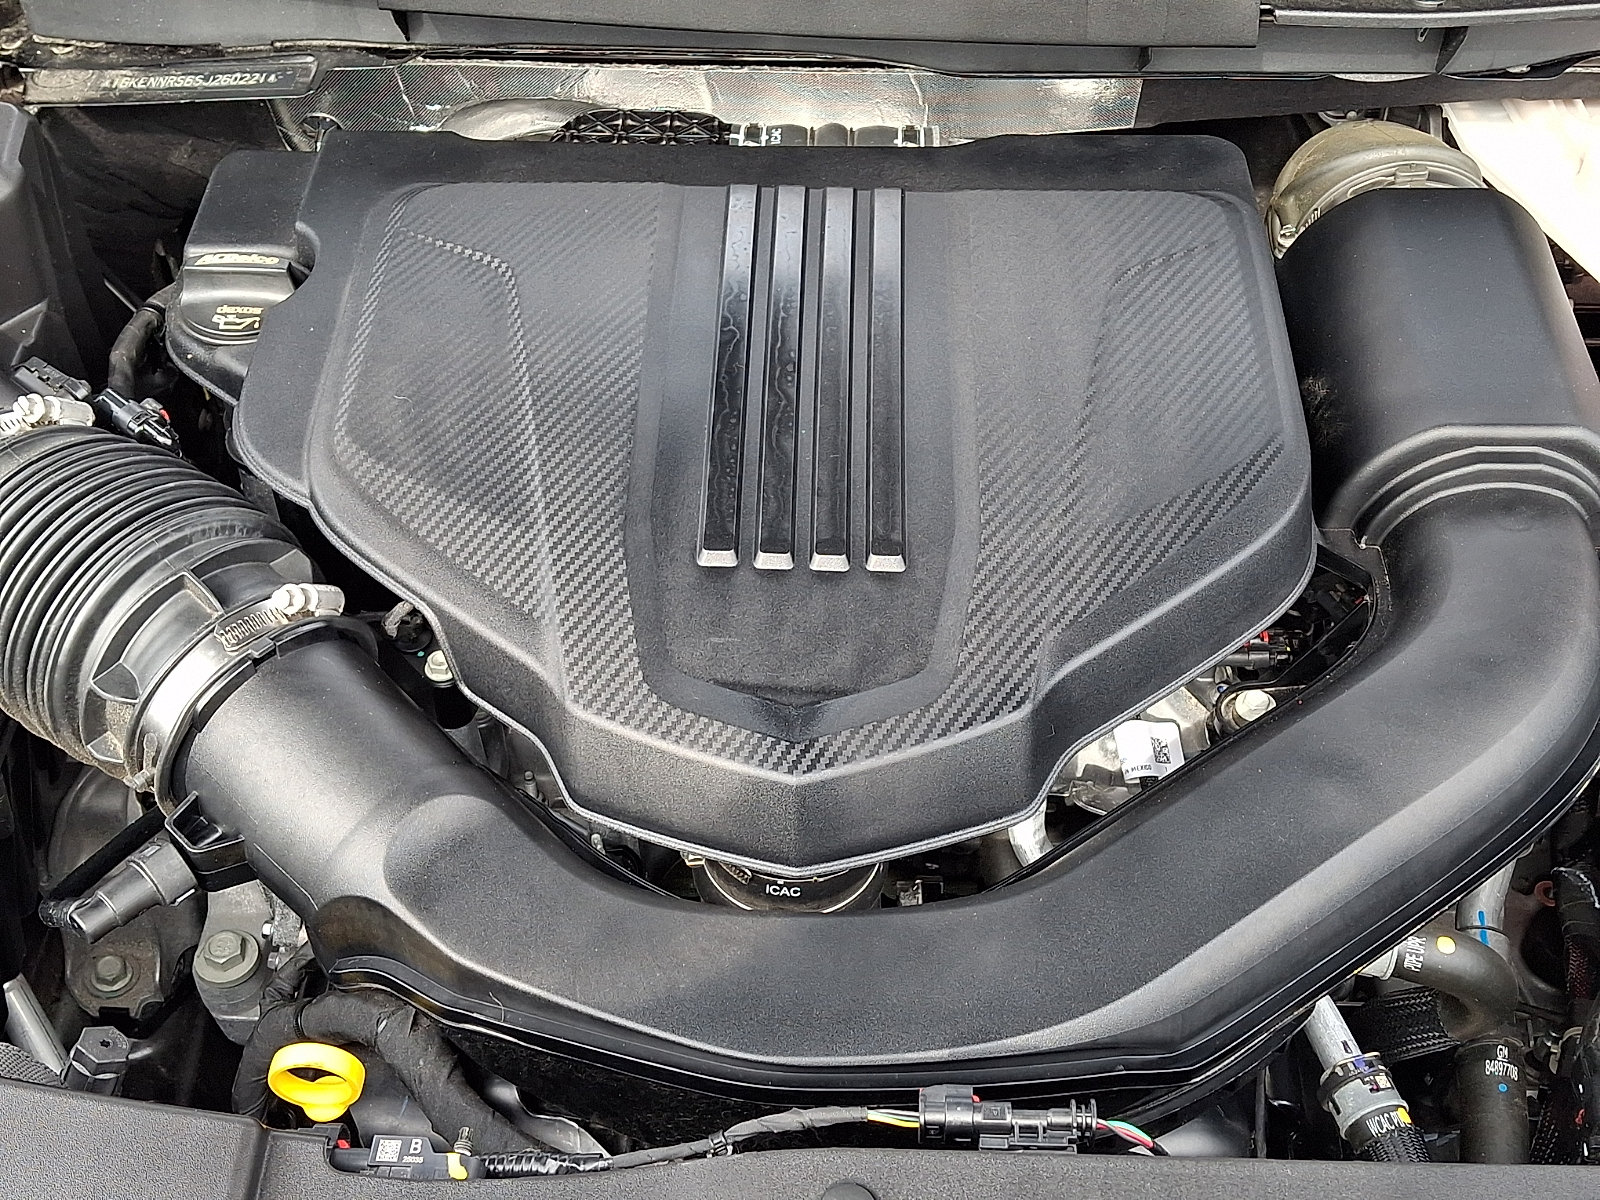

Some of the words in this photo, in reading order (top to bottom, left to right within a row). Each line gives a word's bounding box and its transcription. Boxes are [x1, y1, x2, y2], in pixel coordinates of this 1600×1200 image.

[765, 883, 801, 898] ICAC
[1403, 952, 1424, 972] PIPE
[1496, 1044, 1509, 1059] GM
[409, 1138, 423, 1155] B
